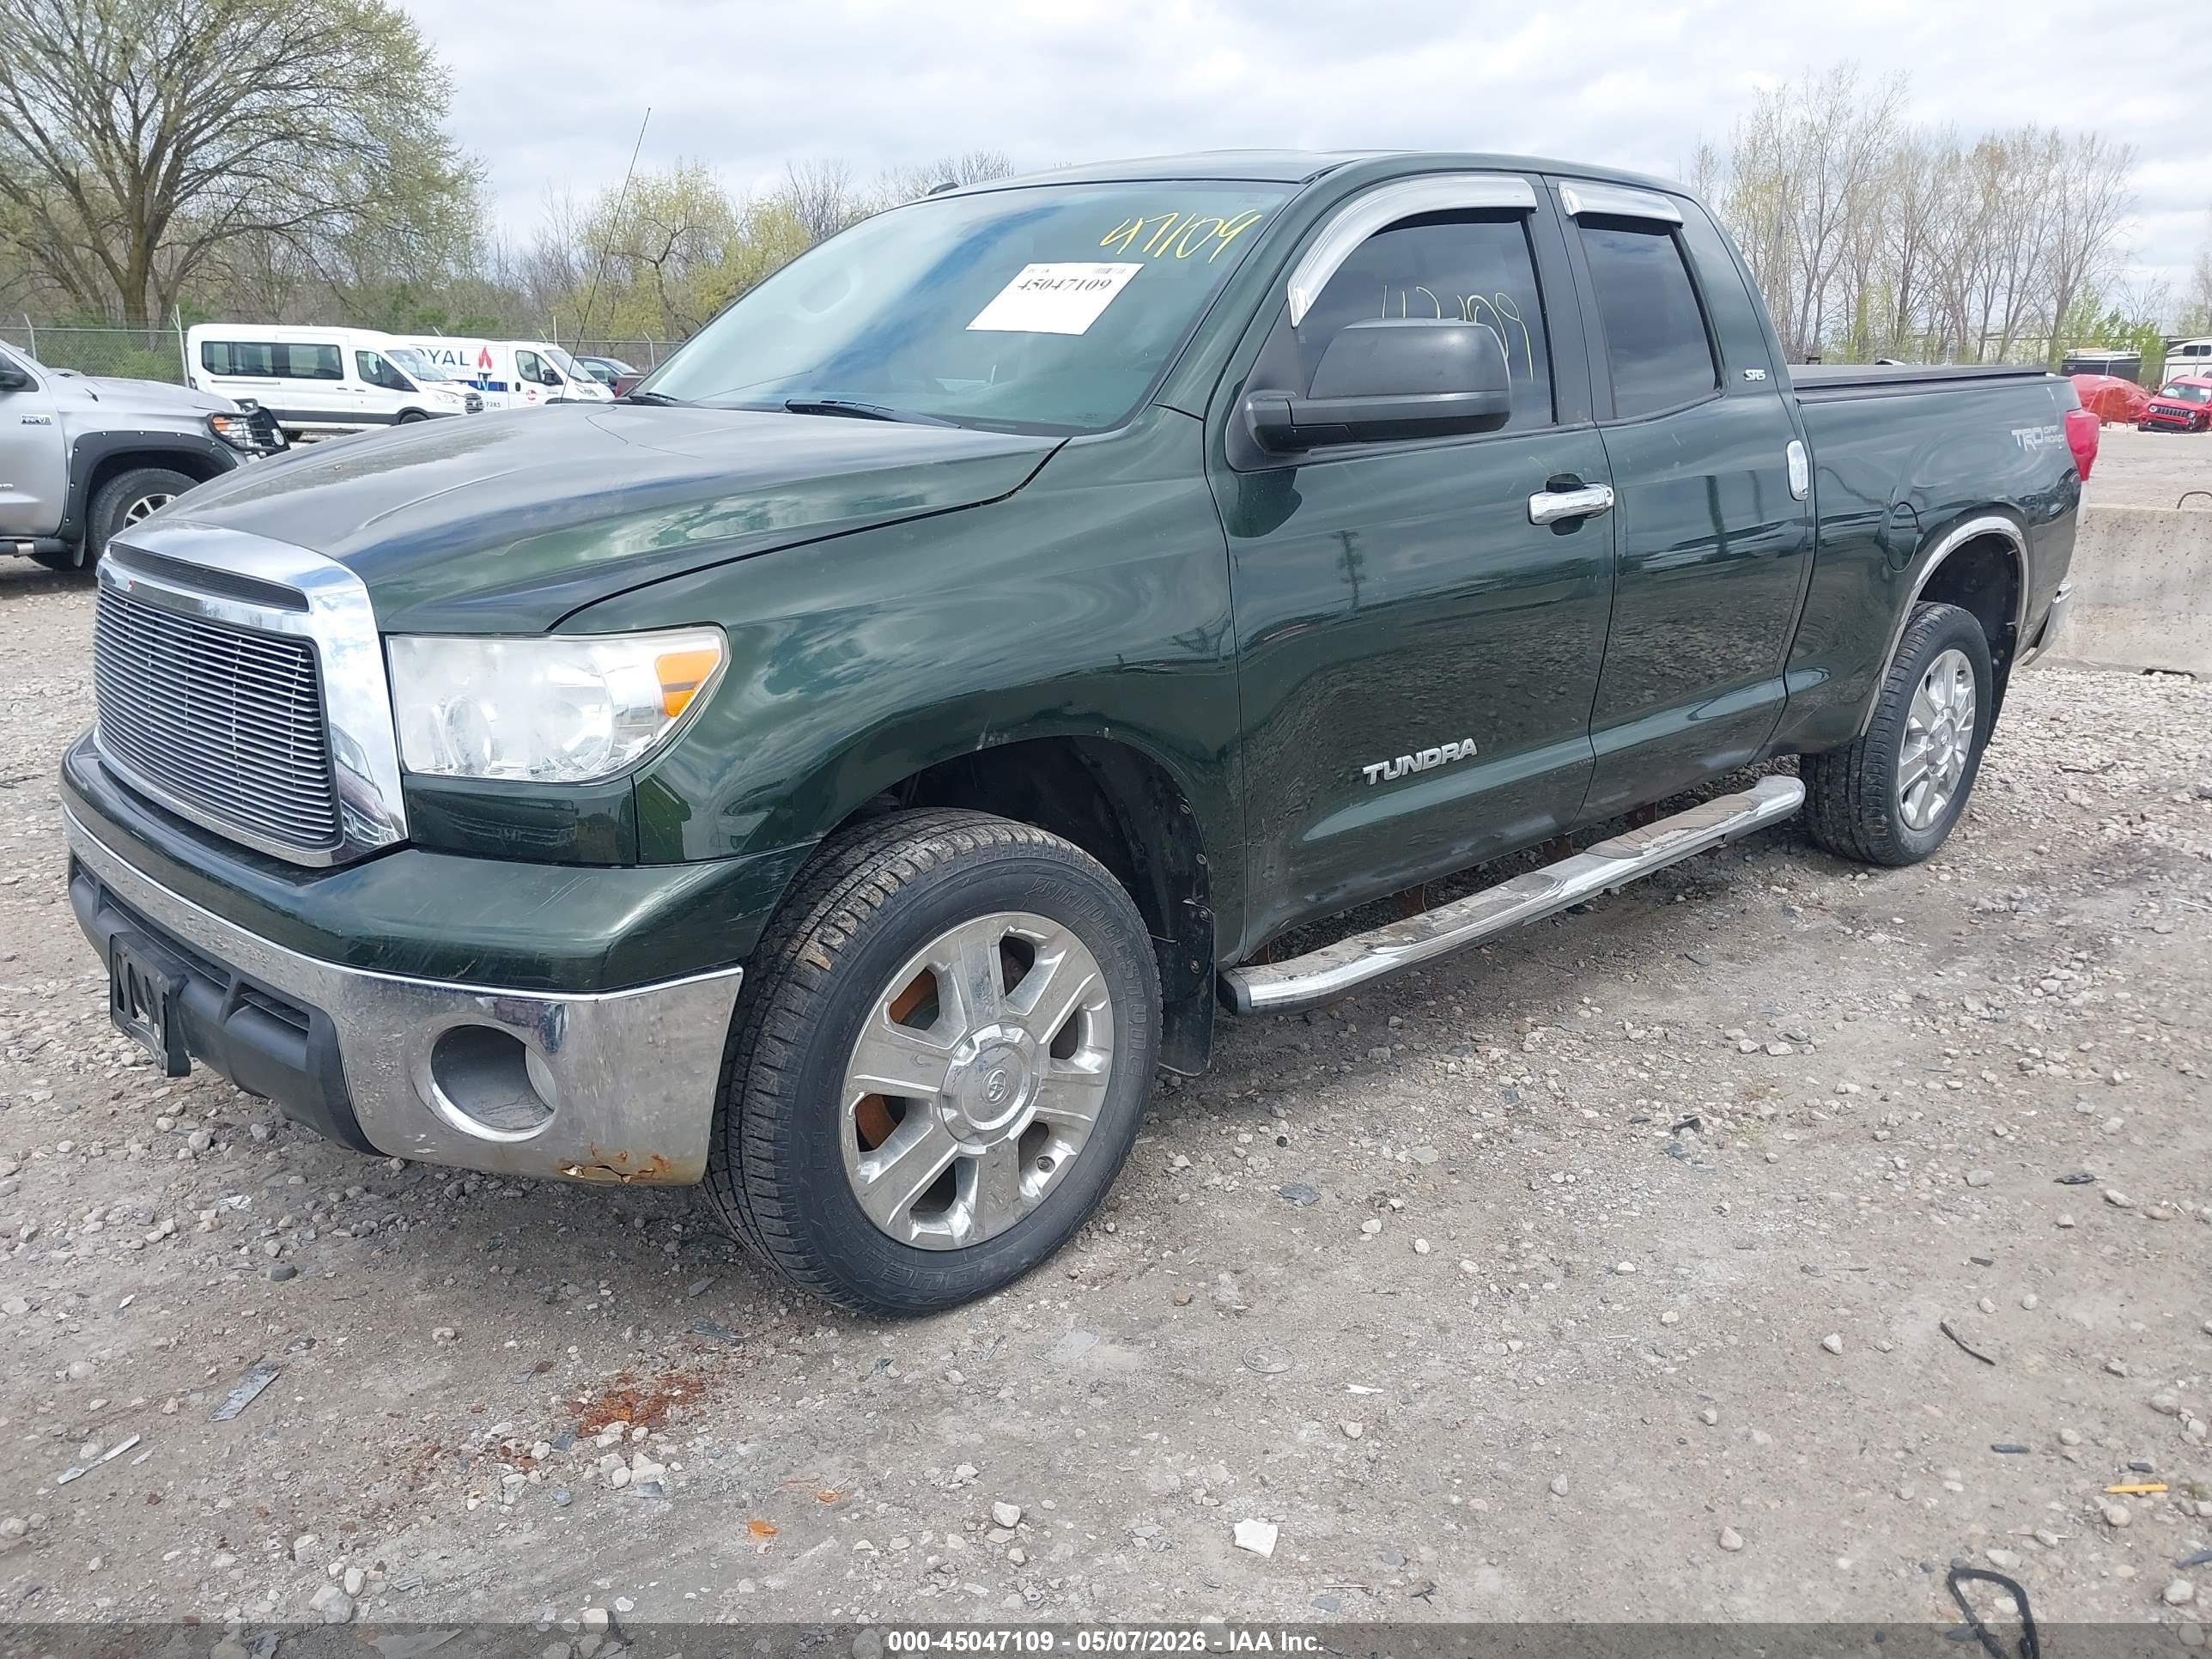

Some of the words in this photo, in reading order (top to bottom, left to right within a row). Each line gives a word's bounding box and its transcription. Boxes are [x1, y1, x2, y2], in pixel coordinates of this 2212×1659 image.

[1018, 278, 1113, 291] 45047109
[416, 348, 471, 366] YAL
[2011, 427, 2044, 452] TRD
[1362, 738, 1478, 786] TUNDRA
